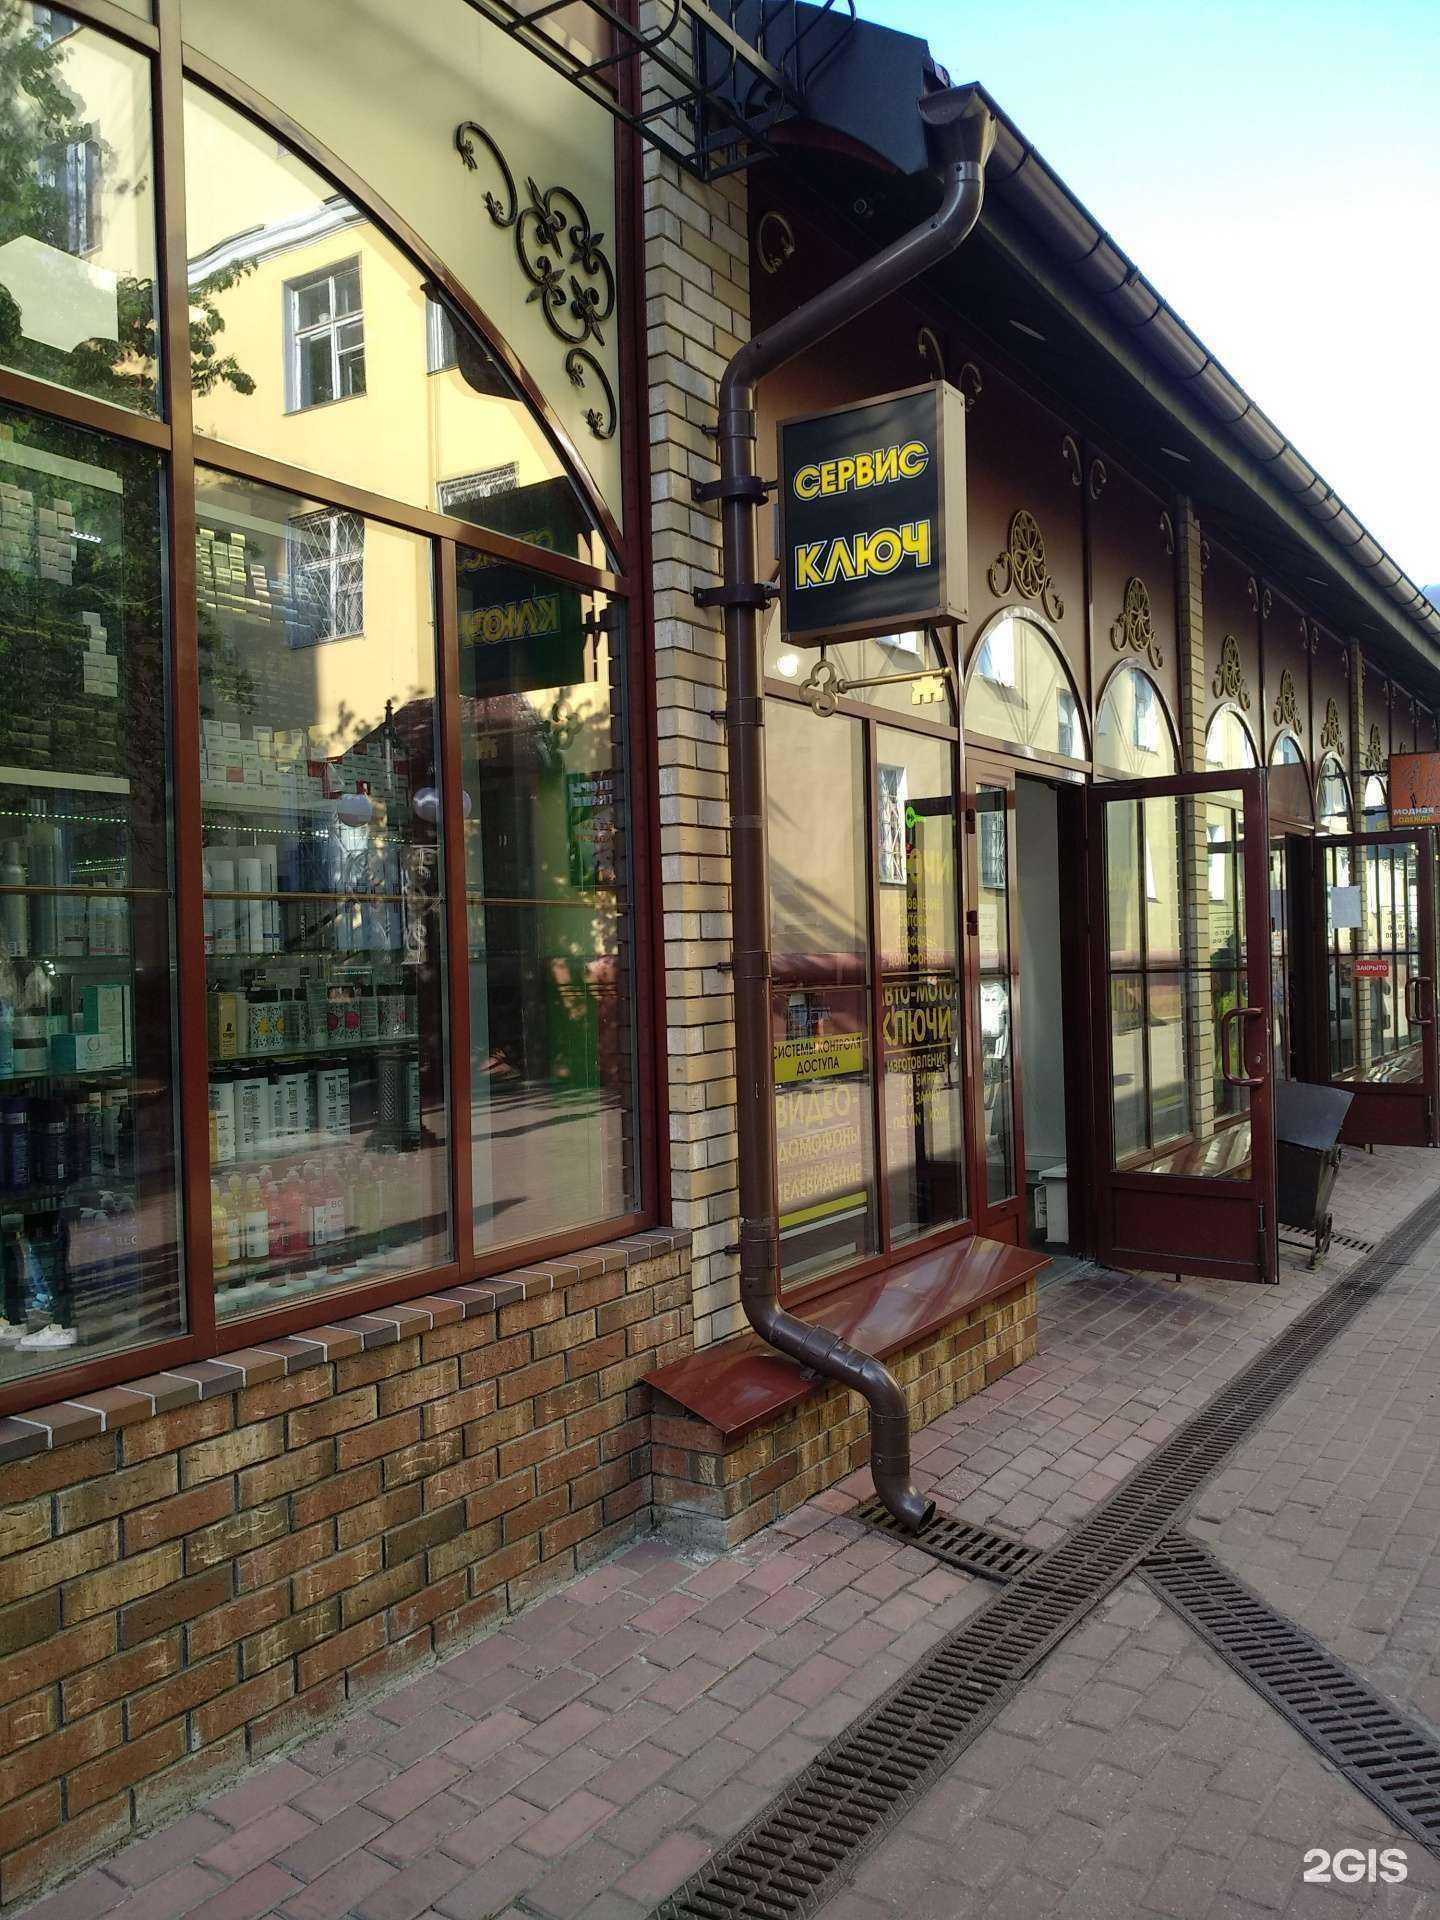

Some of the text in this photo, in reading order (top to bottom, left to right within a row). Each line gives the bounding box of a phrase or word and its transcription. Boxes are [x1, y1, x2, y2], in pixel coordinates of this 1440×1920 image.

[793, 440, 930, 501] СЕРВИС
[795, 519, 931, 590] КЛЮЧ
[881, 982, 954, 1008] ВТО-МОТО
[772, 1042, 816, 1060] СИСТЕМЫ
[886, 1052, 947, 1073] ИЗГОТОВЛЕНИЕ
[796, 1055, 840, 1077] ДОСТУПА
